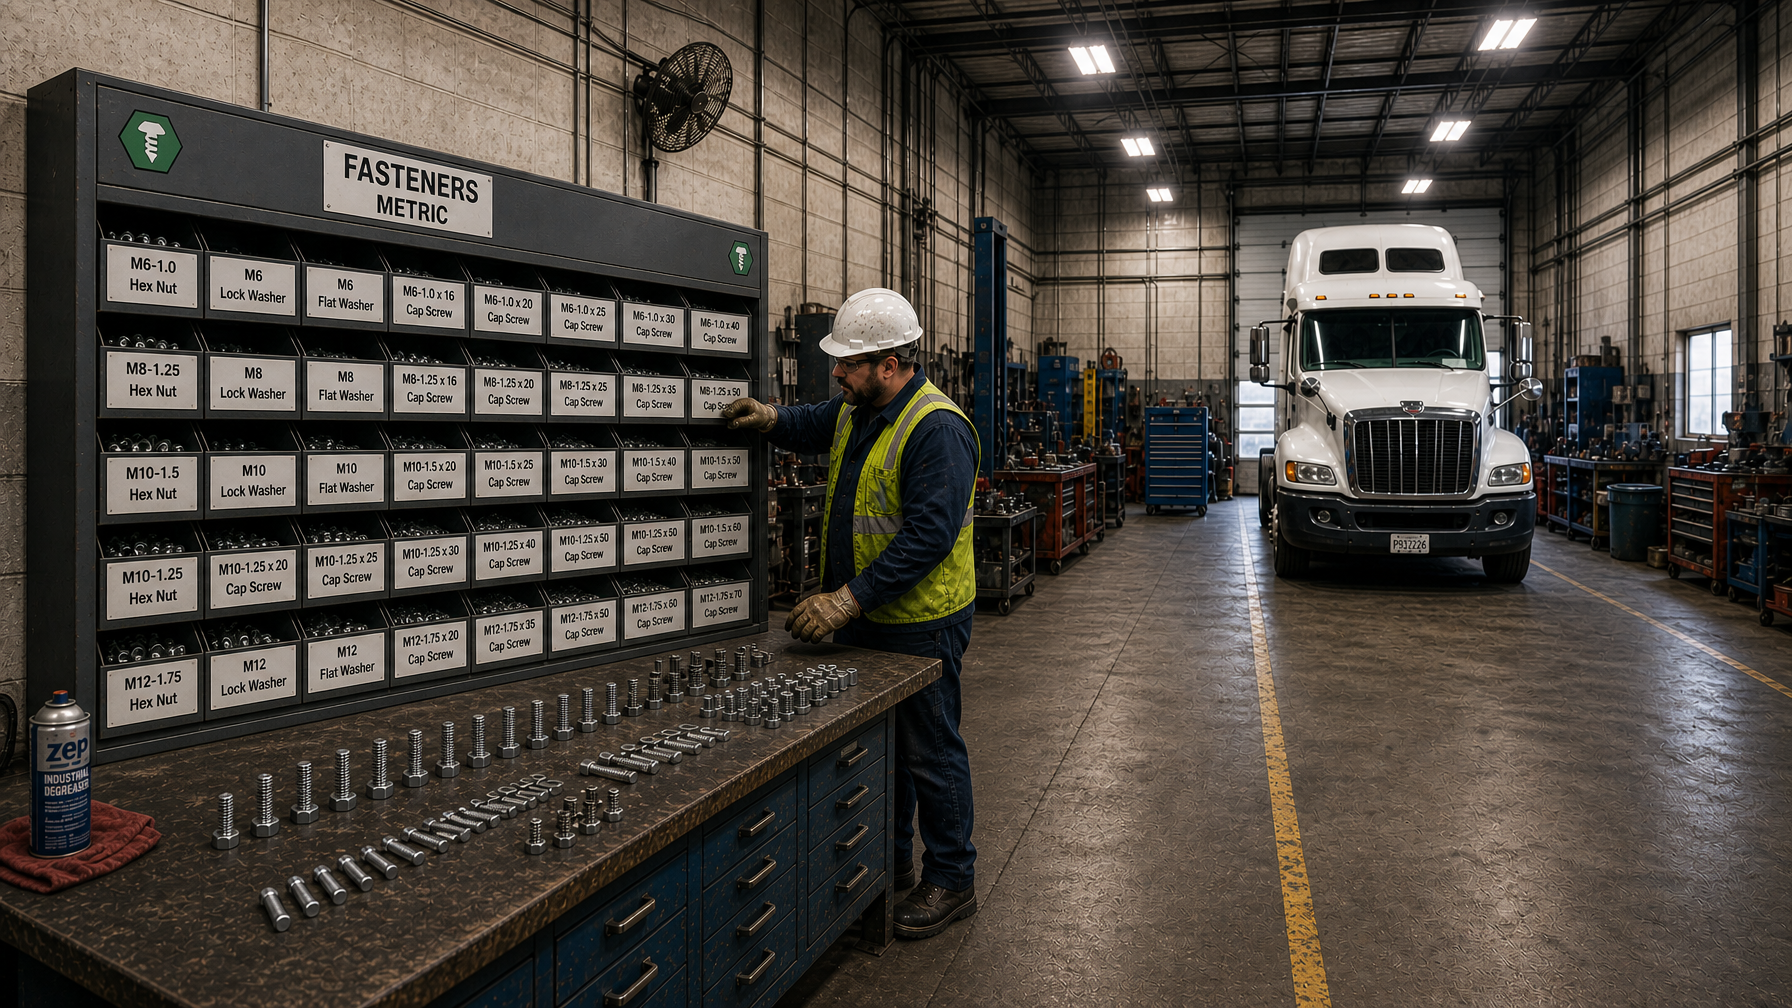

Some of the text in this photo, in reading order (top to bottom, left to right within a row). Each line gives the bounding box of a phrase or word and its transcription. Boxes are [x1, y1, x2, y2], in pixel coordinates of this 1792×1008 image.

[344, 153, 479, 203] FASTENERS
[377, 194, 448, 225] METRIC
[131, 256, 176, 274] M6-1.0
[245, 268, 263, 282] M6
[130, 278, 178, 295] Hex Nut
[338, 278, 354, 291] M6
[220, 286, 287, 304] Lock Washer
[403, 285, 455, 301] M6-1.0 x 16
[318, 295, 375, 311] Flat Washer
[484, 294, 533, 309] M6-1.0 x 20
[406, 304, 453, 319] Cap Screw
[561, 302, 606, 317] M6-1.0 x 25
[487, 311, 530, 325] Cap Screw
[665, 314, 676, 324] 30
[564, 319, 604, 332] Cap Screw
[636, 326, 673, 339] Cap Screw
[703, 332, 737, 345] Cap Screw
[127, 362, 180, 377] M8-1.25
[245, 367, 263, 379] M8
[338, 371, 354, 383] M8
[402, 373, 457, 386] M8-1.25 x 16
[484, 376, 534, 389] M8-1.25 x 20
[130, 384, 177, 398] Hex Nut
[560, 380, 591, 391] M8-1.25
[598, 382, 608, 392] 25
[667, 385, 677, 394] 35
[220, 387, 287, 400] Lock Washer
[319, 389, 375, 402] Flat Washer
[407, 391, 453, 405] Cap Screw
[488, 394, 530, 407] Cap Screw
[564, 396, 604, 409] Cap Screw
[636, 399, 673, 411] Cap Screw
[337, 462, 357, 474] M10
[403, 461, 457, 472] M10-1.5 x 20
[484, 459, 534, 470] M10-1.5 x 25
[560, 458, 591, 469] M10-1.5
[597, 458, 608, 468] 30
[667, 457, 677, 467] 40
[126, 466, 180, 480] M10-1.5
[242, 464, 266, 477] M10
[704, 470, 738, 482] Cap Screw
[488, 477, 531, 490] Cap Screw
[564, 474, 604, 487] Cap Screw
[636, 472, 673, 485] Cap Screw
[221, 484, 287, 498] Lock Washer
[319, 481, 375, 494] Flat Washer
[408, 479, 454, 493] Cap Screw
[130, 487, 177, 501] Hex Nut
[483, 540, 519, 553] M10-1.25
[525, 539, 536, 549] 40
[637, 544, 673, 557] Cap Screw
[704, 538, 738, 550] Cap Screw
[403, 545, 459, 560] M10-1.25 x 30
[565, 550, 604, 564] Cap Screw
[315, 552, 378, 568] M10-1.25 x 25
[489, 557, 531, 571] Cap Screw
[219, 559, 288, 576] M10-1.25 x 20
[408, 564, 454, 579] Cap Screw
[123, 567, 183, 585] M10-1.25
[322, 572, 372, 588] Cap Screw
[226, 581, 282, 597] Cap Screw
[129, 589, 178, 605] Hex Nut
[704, 606, 739, 619] Cap Screw
[484, 618, 536, 636] M12-1.75 x 35
[637, 616, 674, 630] Cap Screw
[403, 629, 459, 648] M12-1.75 x 20
[565, 627, 604, 641] Cap Screw
[337, 644, 357, 658] M12
[489, 638, 531, 654] Cap Screw
[408, 650, 454, 666] Cap Screw
[243, 658, 267, 673] M12
[320, 662, 375, 680] Flat Washer
[125, 670, 182, 691] M12-1.75
[221, 676, 287, 697] Lock Washer
[130, 692, 178, 711] Hex Nut
[45, 737, 88, 762] zep
